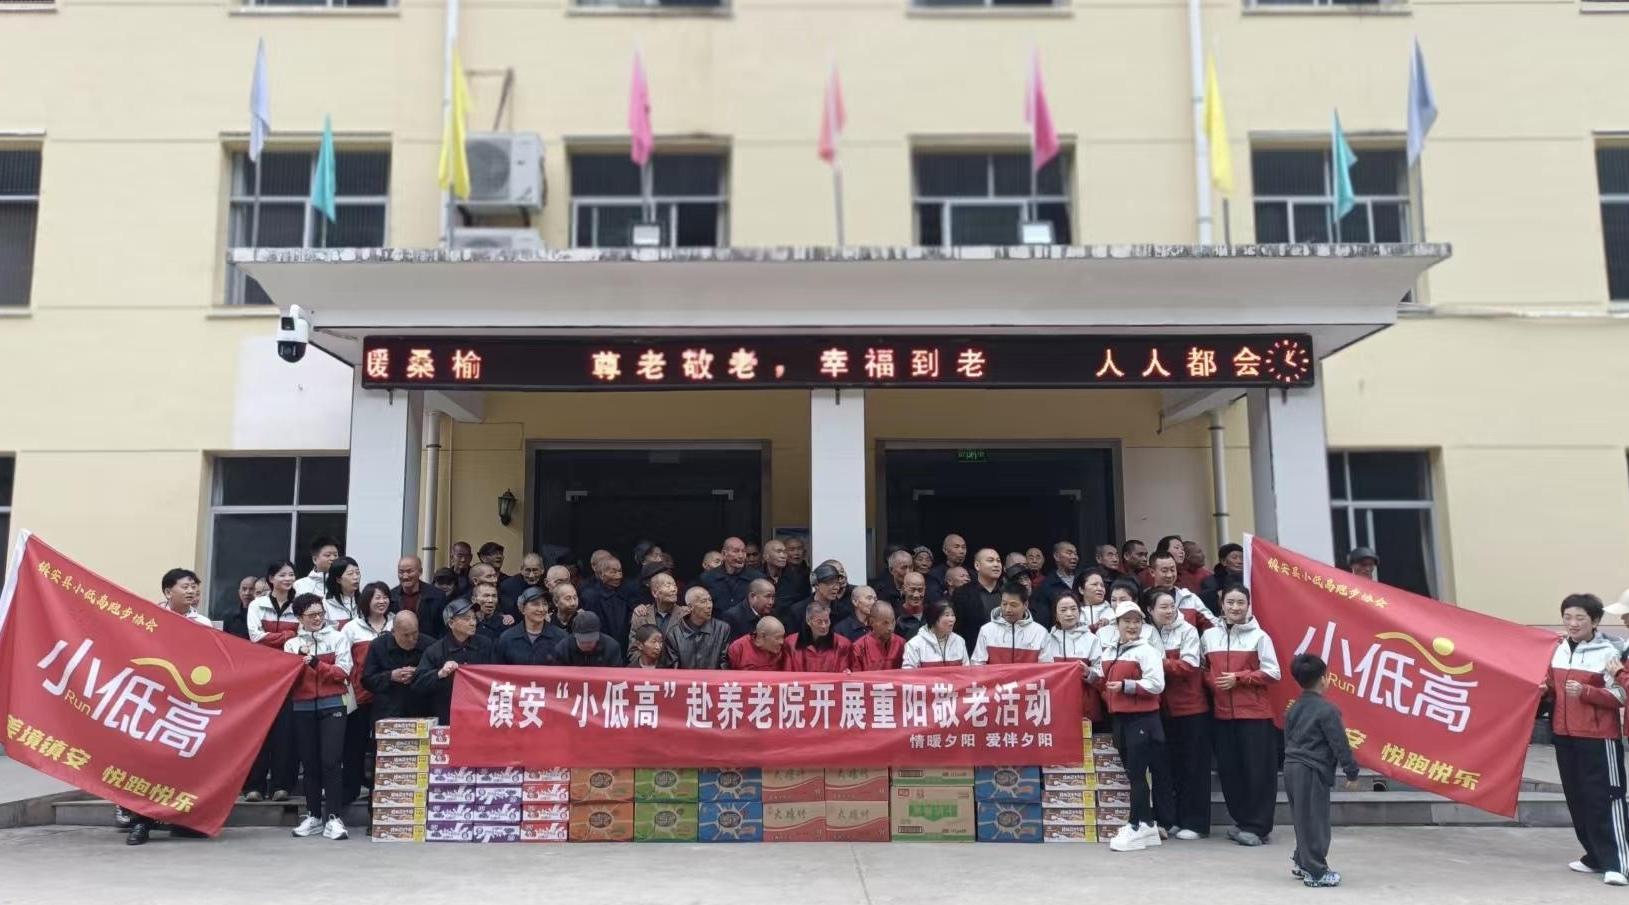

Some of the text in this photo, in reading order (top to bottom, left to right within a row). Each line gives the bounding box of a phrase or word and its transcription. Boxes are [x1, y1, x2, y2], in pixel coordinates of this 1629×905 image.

[366, 347, 482, 379] 暖桑榆
[1095, 346, 1262, 377] 人人都会
[1293, 620, 1479, 733] 小低高
[1327, 672, 1356, 695] Run
[36, 638, 223, 758] 小低高
[63, 688, 92, 716] Run
[909, 732, 1053, 748] 情暖夕阳 爱伴夕阳
[1380, 742, 1481, 790] 悦跑悦乐
[101, 764, 199, 813] 悦跑悦乐
